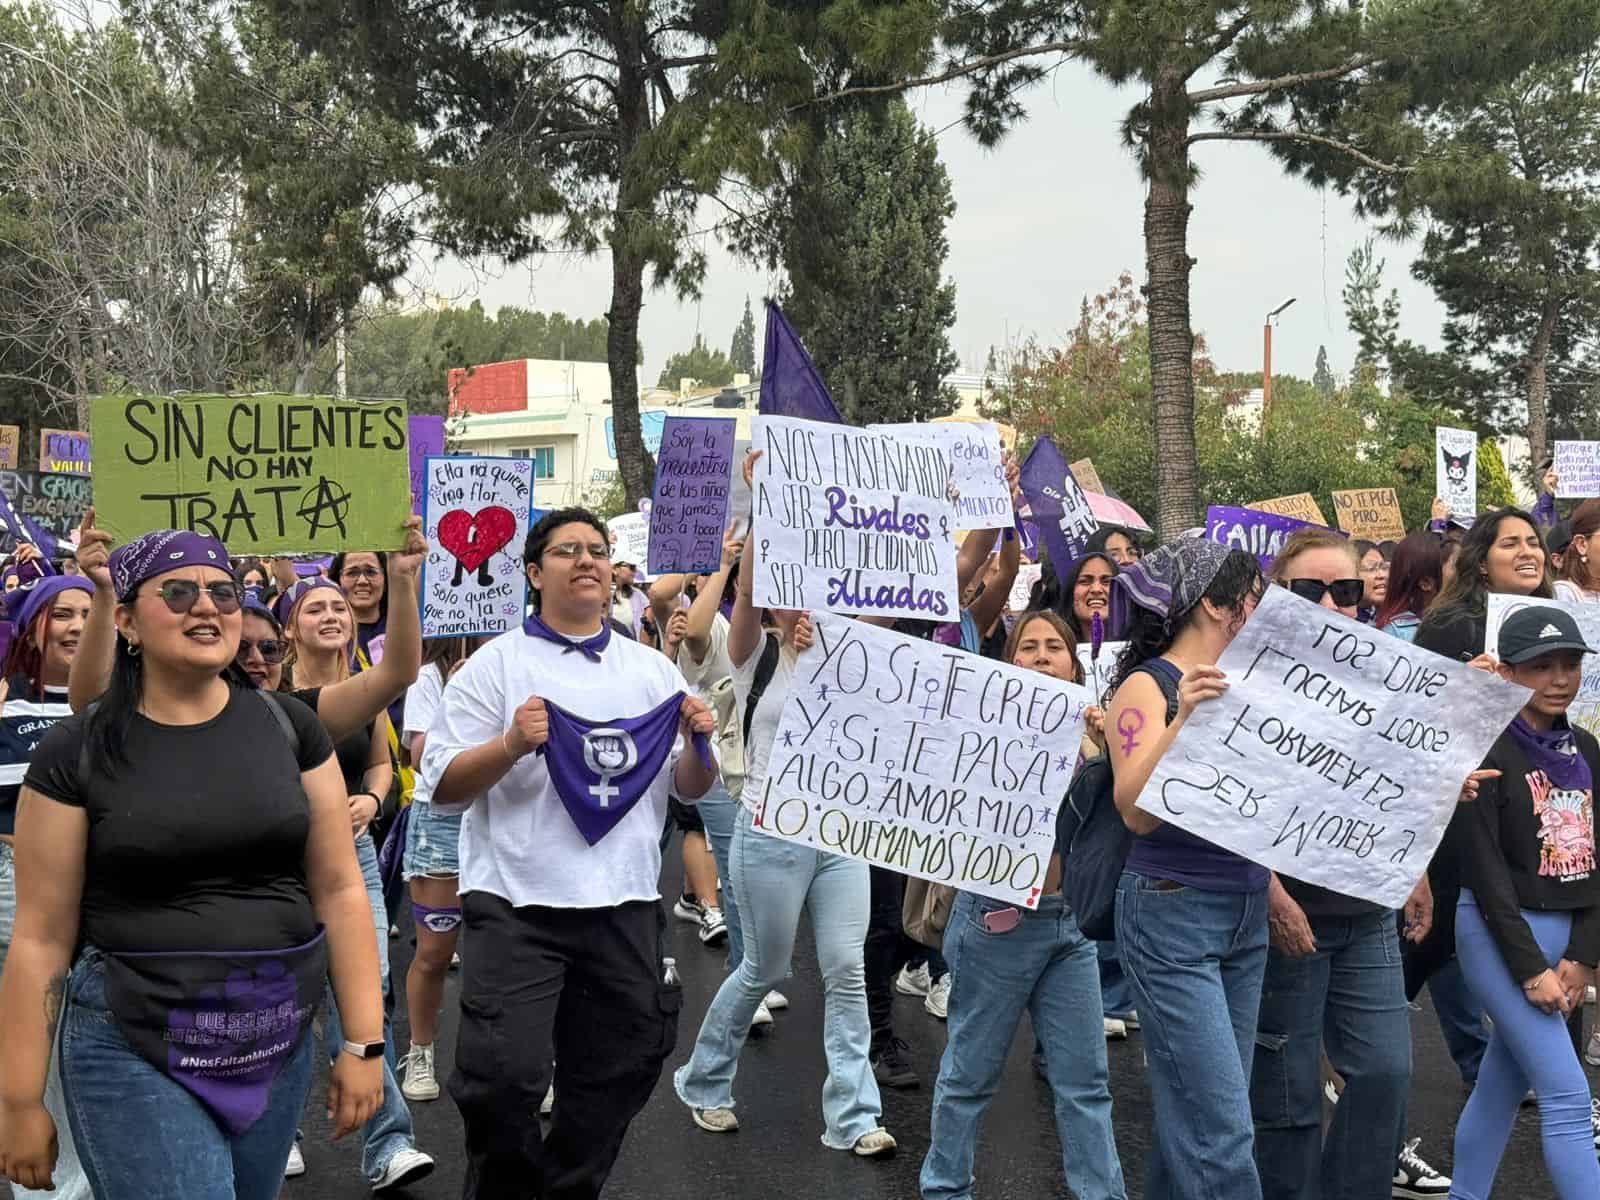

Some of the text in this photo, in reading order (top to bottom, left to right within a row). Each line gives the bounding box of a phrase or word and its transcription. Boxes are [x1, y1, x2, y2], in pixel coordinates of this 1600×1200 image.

[125, 400, 406, 465] SIN CLIENTES
[670, 427, 694, 459] Soy
[703, 426, 716, 449] la
[206, 455, 313, 482] NO HAY
[660, 450, 729, 478] maestra
[765, 424, 953, 502] NOS ENSEÑARON
[435, 462, 464, 486] Ella
[490, 465, 529, 500] quiere
[660, 479, 676, 498] de
[679, 479, 698, 499] las
[140, 475, 352, 543] TRATA
[655, 503, 675, 522] que
[758, 481, 931, 540] A SER Rivales
[1334, 494, 1353, 509] NO
[1354, 491, 1369, 508] TE
[652, 522, 674, 535] vas
[678, 522, 688, 534] a
[804, 528, 939, 577] PERO DECIDIMOS
[433, 582, 513, 612] Solo quiere
[767, 562, 949, 616] SER Aliadas
[424, 602, 494, 620] que no la
[437, 616, 507, 634] marchiten
[809, 621, 869, 695] YO
[940, 653, 977, 721] TE
[979, 669, 1069, 735] CREO
[795, 696, 832, 747] Y
[902, 720, 946, 777] TE
[952, 730, 1051, 797] PASA
[878, 778, 968, 827] AMOR
[819, 808, 967, 881] QUEMAMOS
[179, 1039, 291, 1068] #NosFaltanMuchas
